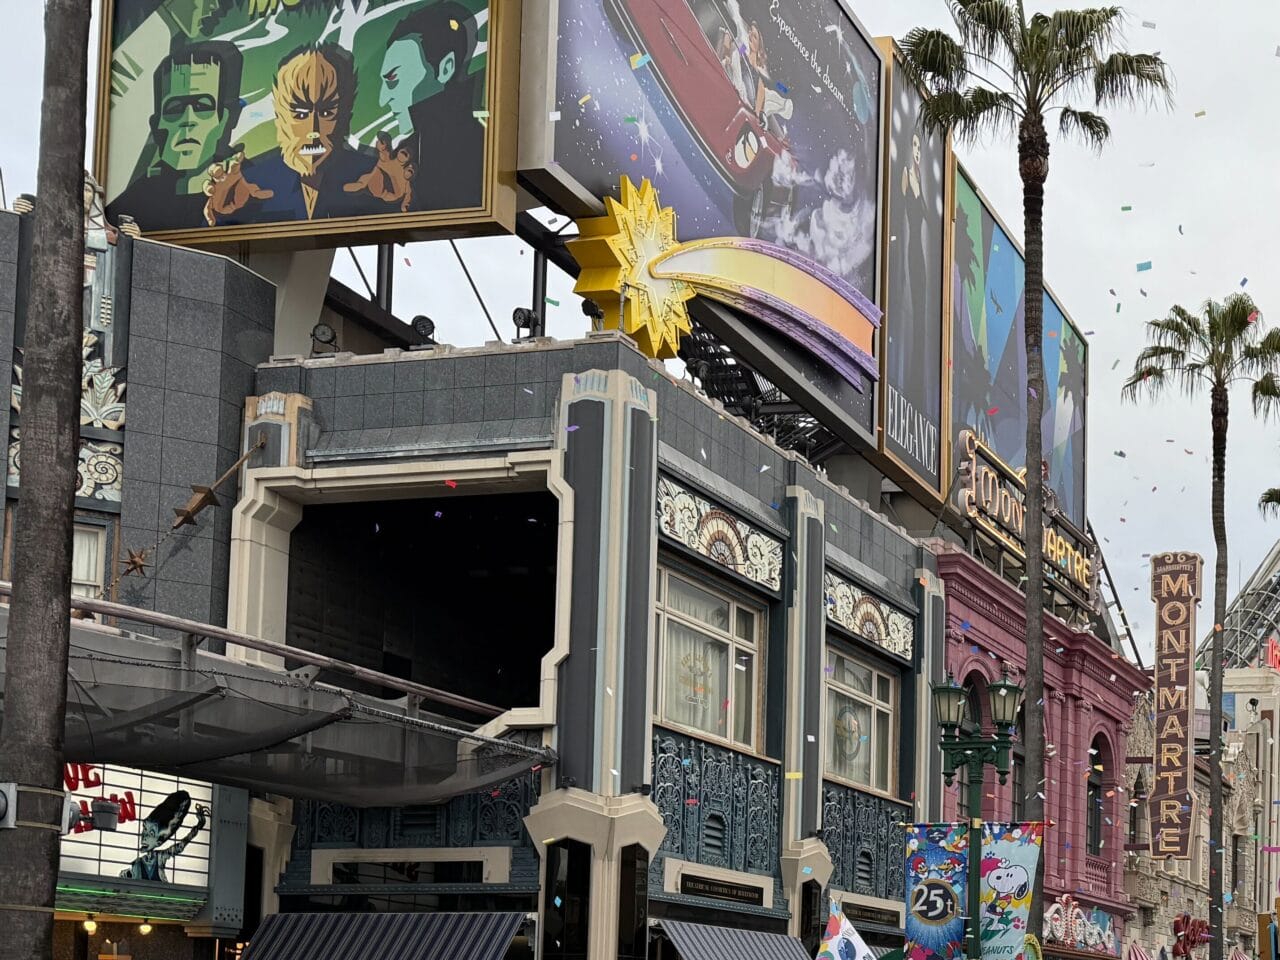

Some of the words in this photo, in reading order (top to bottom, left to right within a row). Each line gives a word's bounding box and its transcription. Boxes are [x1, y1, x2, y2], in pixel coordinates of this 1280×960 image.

[810, 49, 822, 76] the
[888, 384, 937, 477] ELEGANCE
[1159, 573, 1190, 852] MONTMARTRE
[982, 945, 1014, 956] EANUTS
